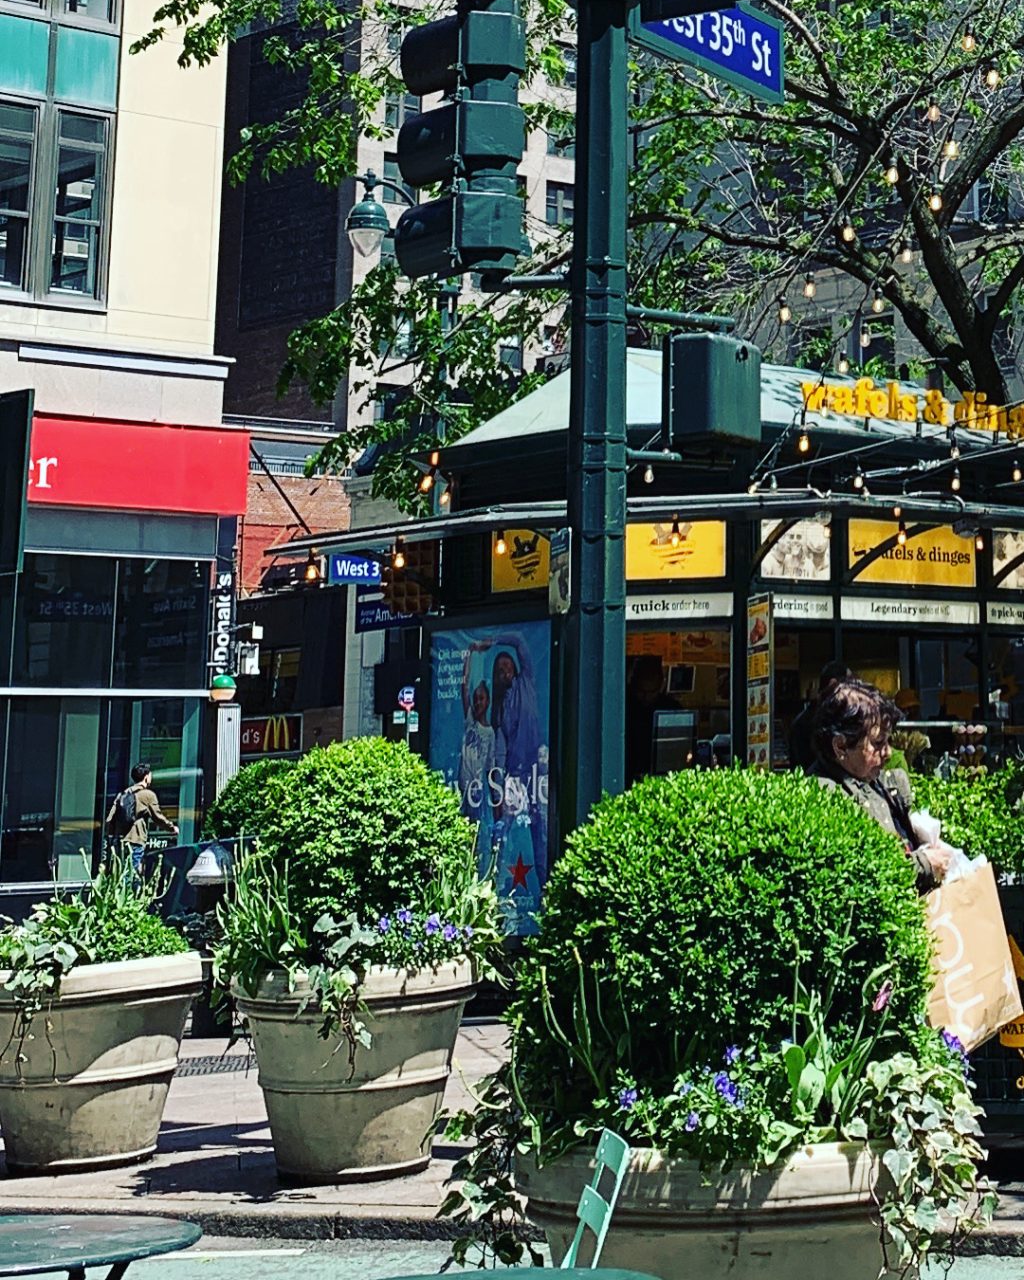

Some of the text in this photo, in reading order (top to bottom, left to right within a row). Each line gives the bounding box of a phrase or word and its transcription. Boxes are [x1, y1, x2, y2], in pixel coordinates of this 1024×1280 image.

[663, 12, 772, 77] est 35th St
[801, 377, 918, 422] wafels
[922, 389, 951, 426] &
[878, 545, 971, 567] afels & dinges
[336, 560, 381, 578] West 3
[631, 599, 670, 614] quick
[773, 598, 809, 612] rdering
[870, 602, 917, 616] Legendary
[487, 763, 549, 816] Style
